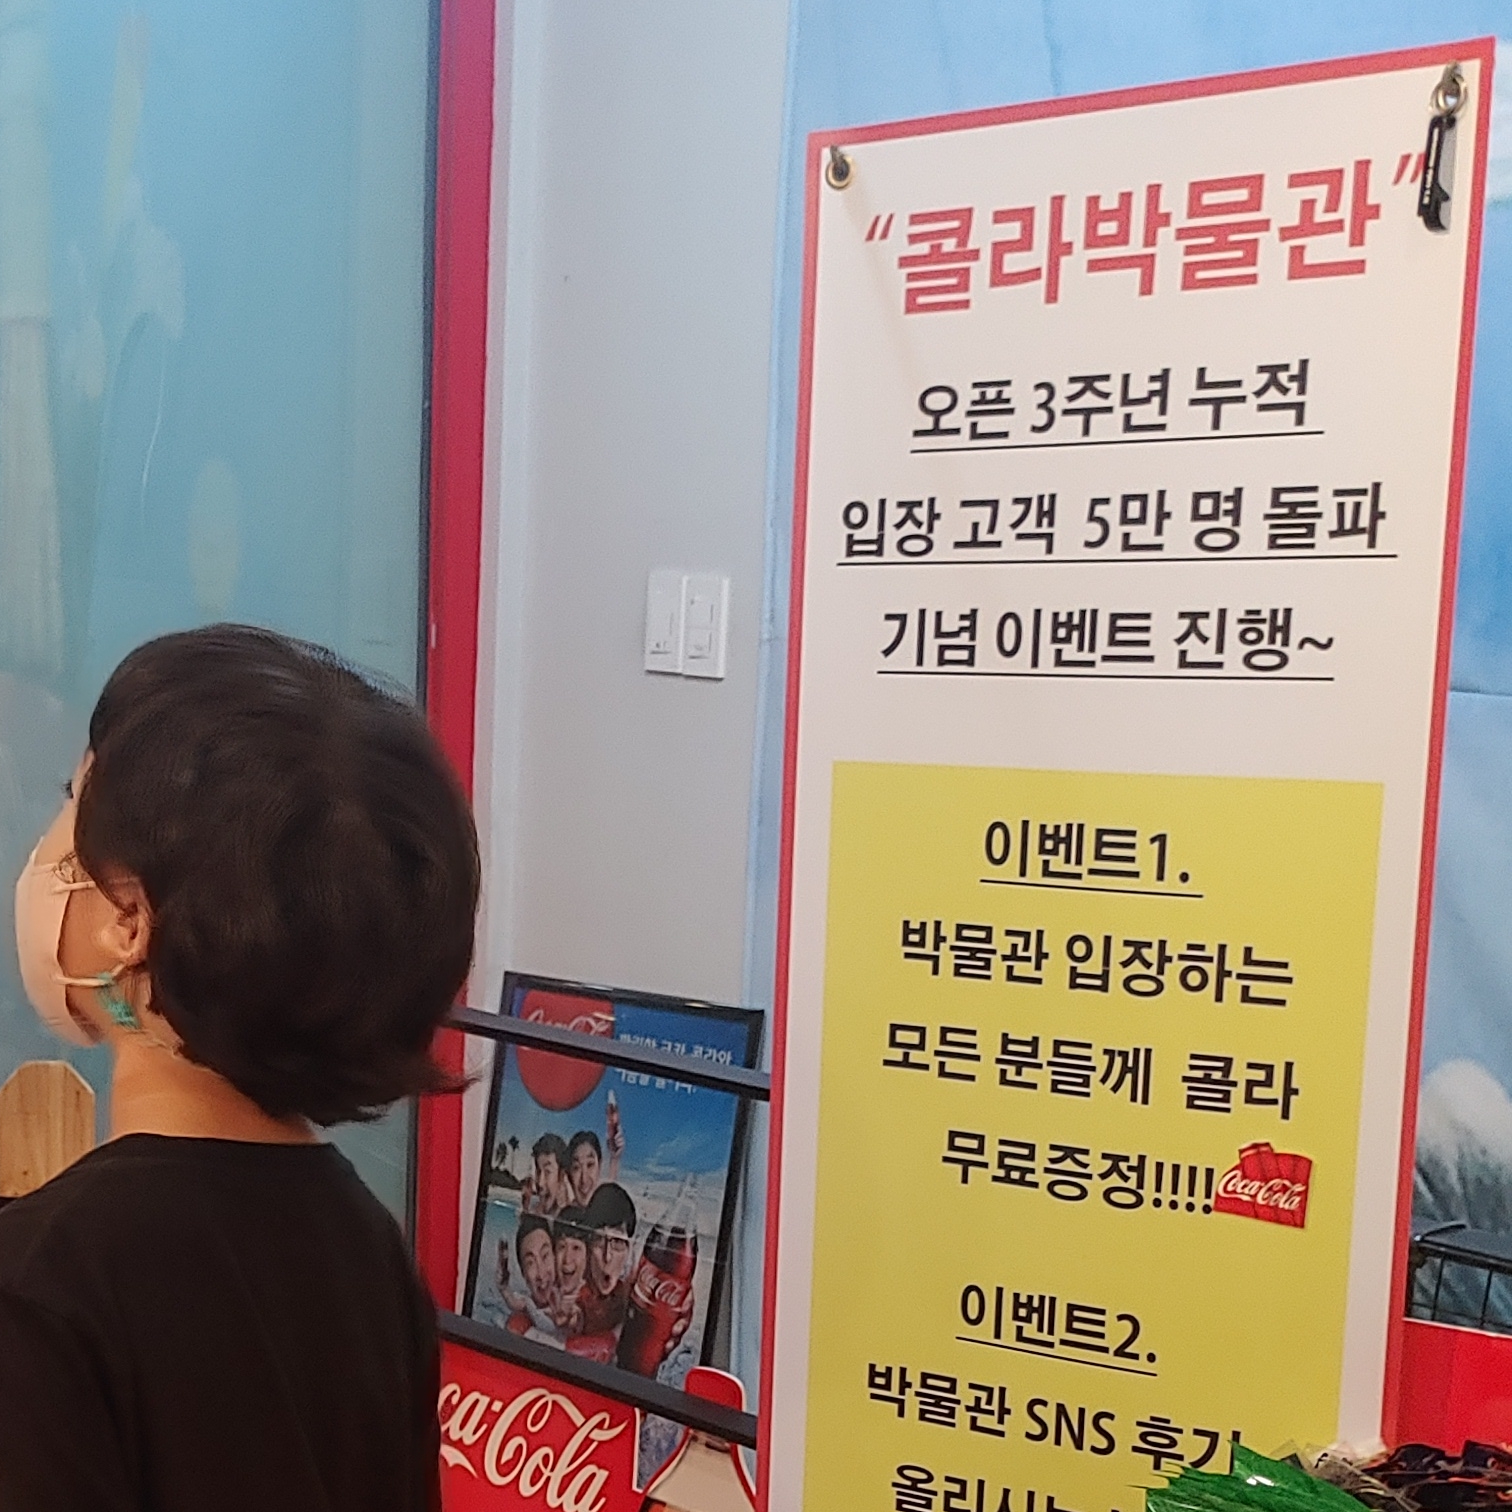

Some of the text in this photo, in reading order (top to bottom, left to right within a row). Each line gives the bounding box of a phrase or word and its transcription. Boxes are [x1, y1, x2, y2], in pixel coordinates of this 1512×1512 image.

[912, 358, 1310, 440] 오픈 3주년 누적
[842, 481, 1386, 557] 입장 고객 5만 명 돌파
[881, 607, 1334, 670] 기념 이벤트 진행~
[984, 819, 1191, 884] 이벤트1.
[901, 919, 1294, 1007] 박물관 입장하는
[882, 1022, 1299, 1120] 모든 분들께 콜라
[941, 1129, 1216, 1215] 무료증정!!!!
[960, 1284, 1158, 1364] 이벤트2.
[866, 1363, 1242, 1475] 박물관 SNS 후기
